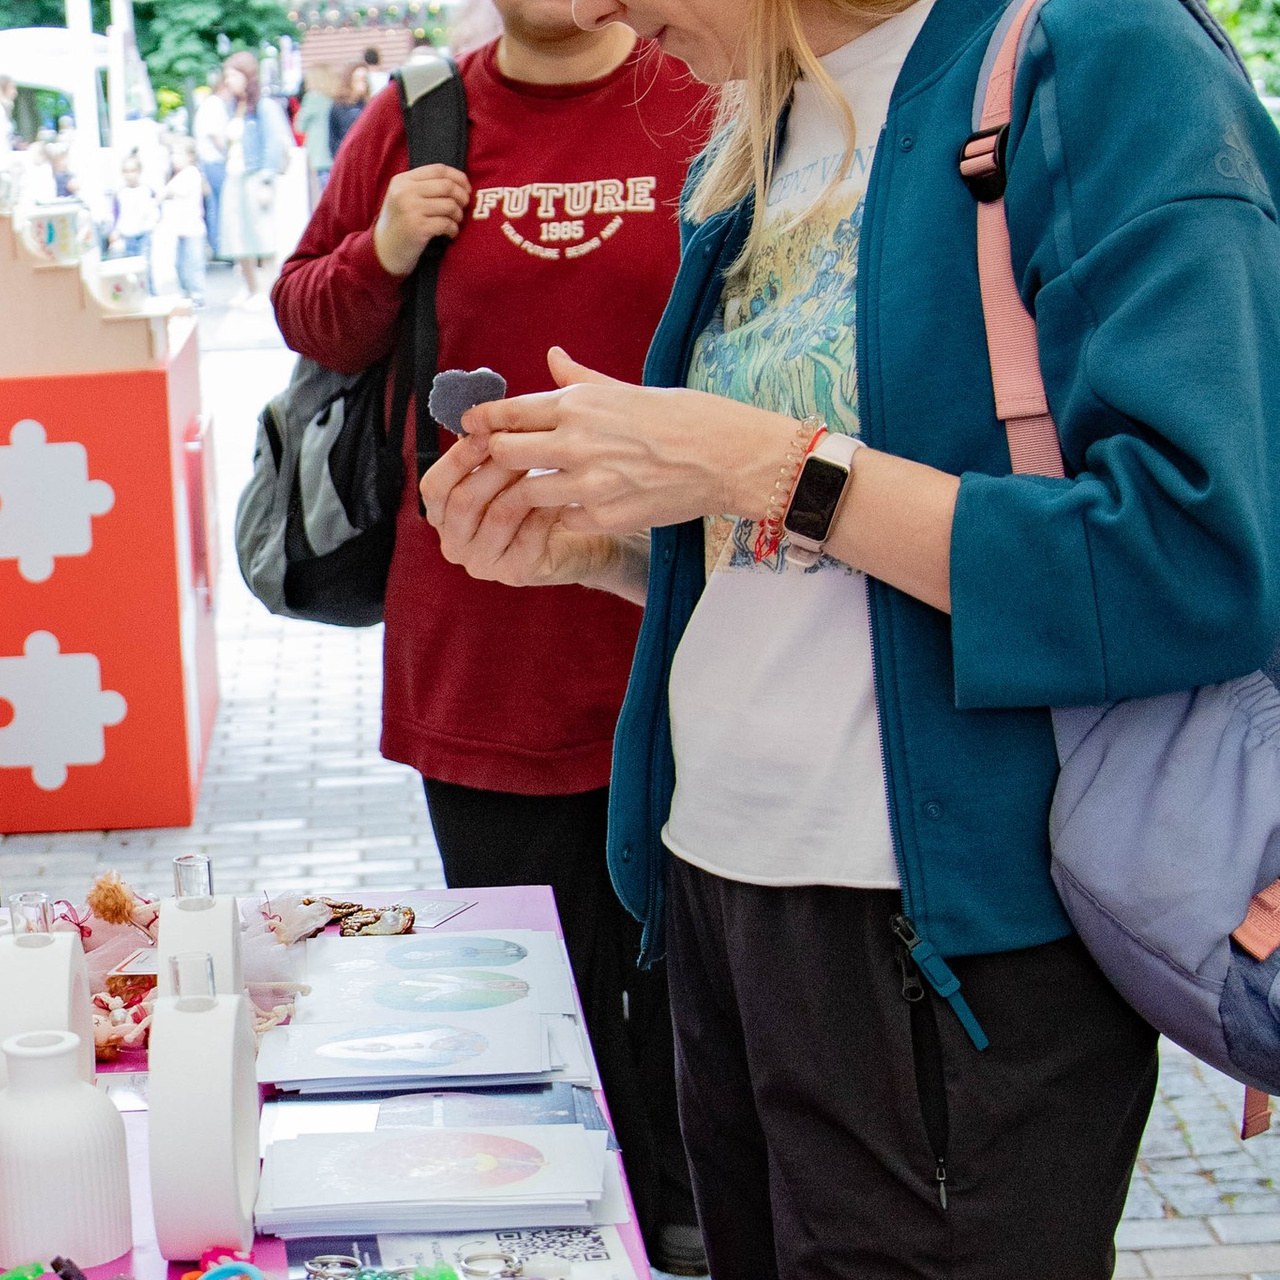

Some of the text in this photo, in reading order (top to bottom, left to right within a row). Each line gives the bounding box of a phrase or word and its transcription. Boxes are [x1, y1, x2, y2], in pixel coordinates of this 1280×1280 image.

[822, 145, 875, 184] VN
[473, 176, 656, 219] FUTURE
[540, 220, 585, 242] 1985
